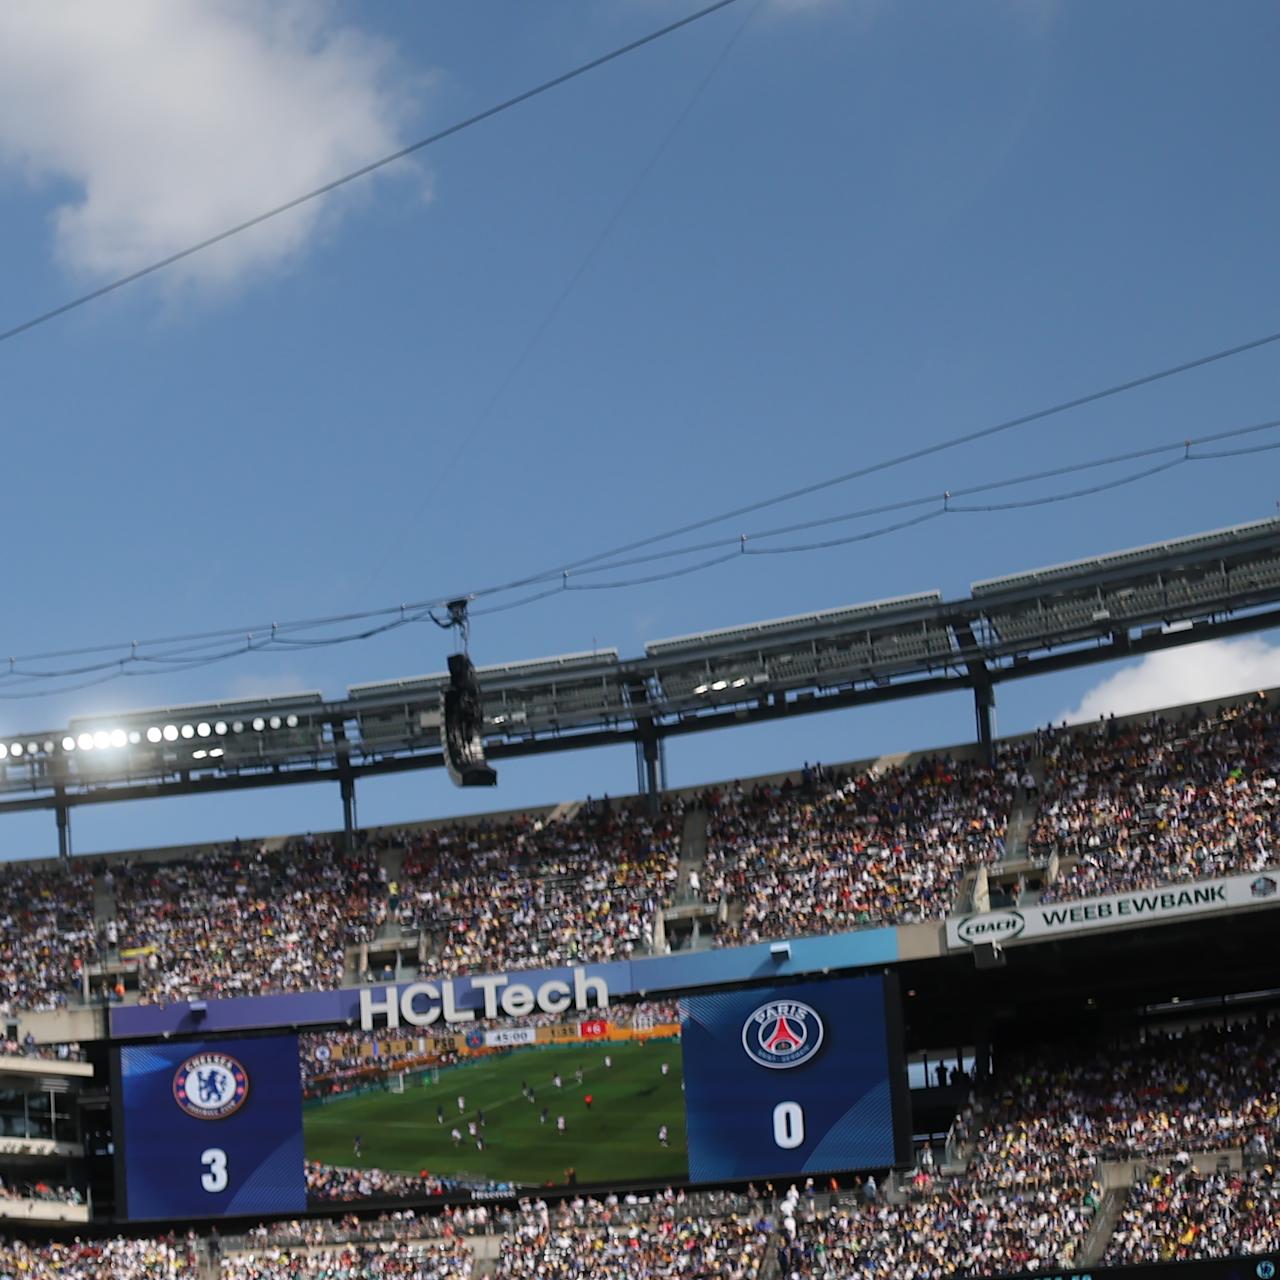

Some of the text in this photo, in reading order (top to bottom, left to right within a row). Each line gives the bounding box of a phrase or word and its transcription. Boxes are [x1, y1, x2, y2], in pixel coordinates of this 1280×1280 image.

[965, 884, 1227, 937] COACH WEEB EWBANK
[359, 966, 611, 1032] HCLTech
[754, 1003, 809, 1025] PARIS
[185, 1054, 233, 1073] CHELSEA
[773, 1101, 804, 1149] 0
[201, 1148, 228, 1192] 3
